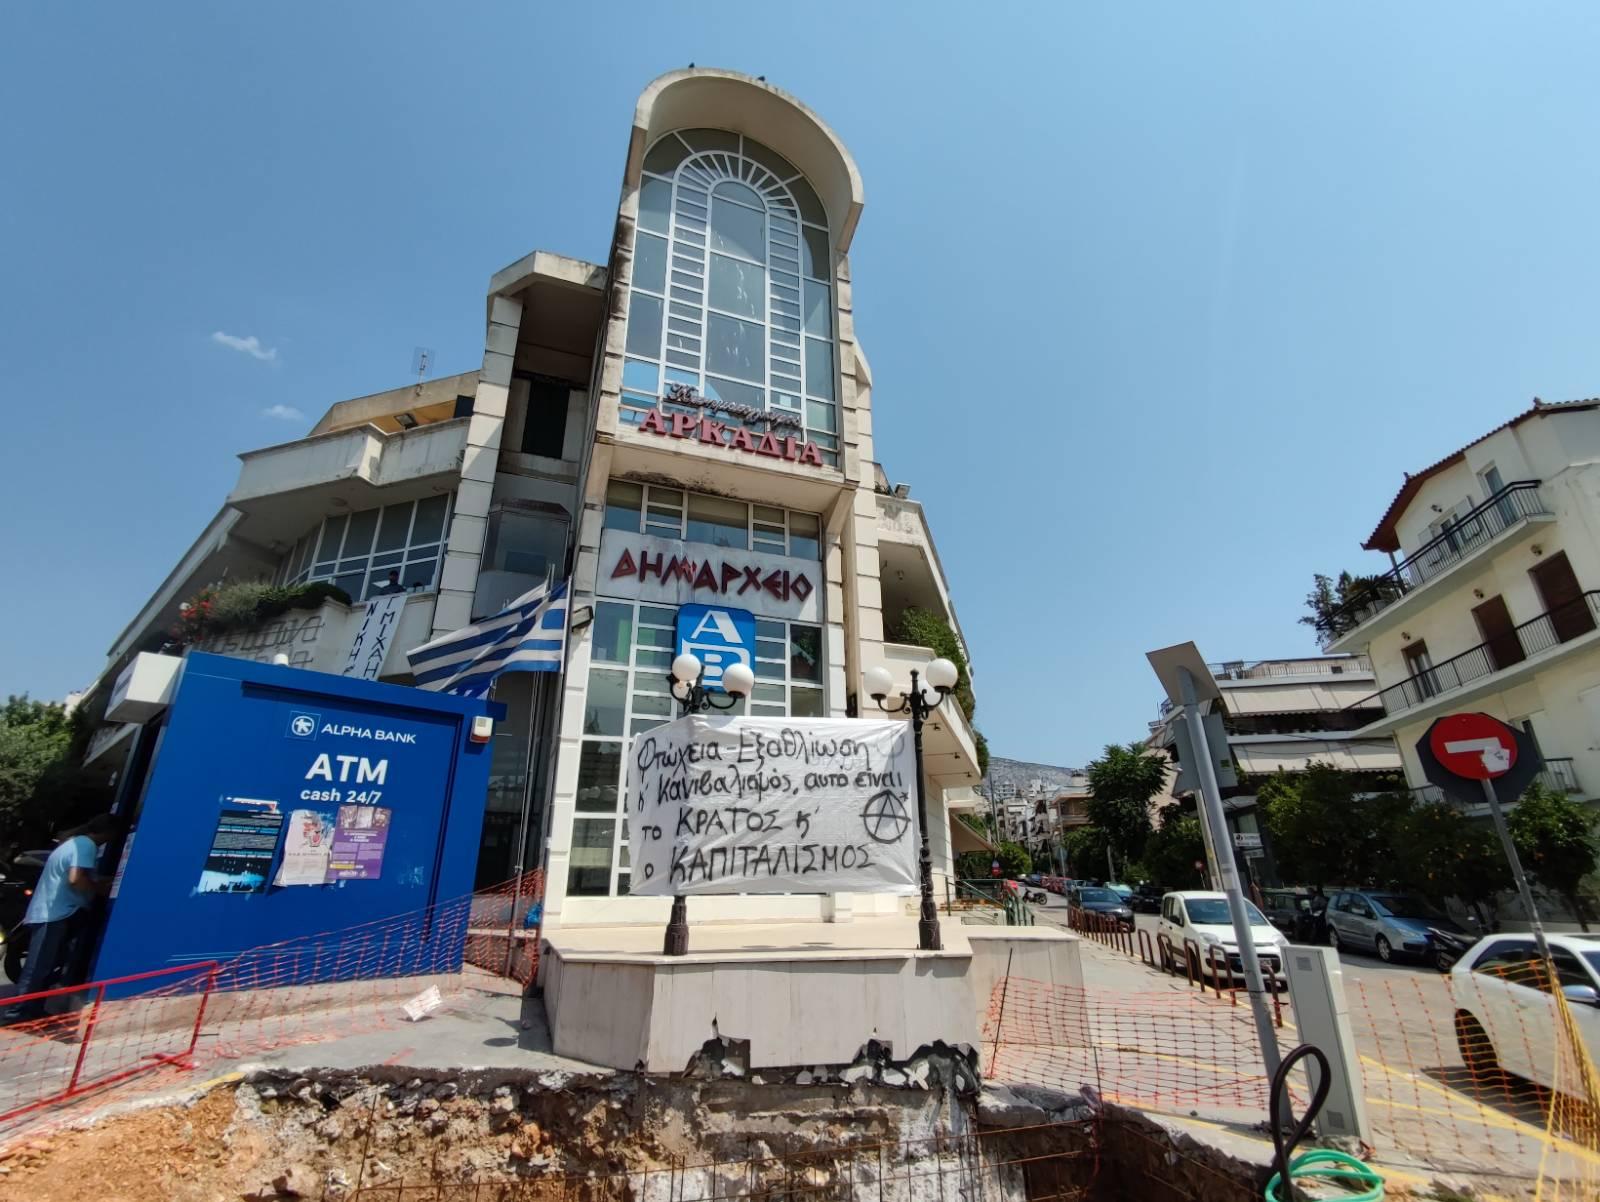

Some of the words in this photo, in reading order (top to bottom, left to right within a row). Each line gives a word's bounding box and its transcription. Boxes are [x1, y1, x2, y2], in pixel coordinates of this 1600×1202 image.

[638, 407, 823, 466] ΑΡΚΑΔΙΑ
[321, 723, 372, 739] ALPHA
[375, 729, 417, 744] BANK
[304, 753, 388, 785] ATM
[300, 788, 341, 801] cash
[346, 790, 382, 804] 24/7
[676, 806, 783, 836] ΚΡΑΤΟΣ
[669, 844, 877, 884] ΚΑΠΙΤΑΛΙΣΜΟΣ
